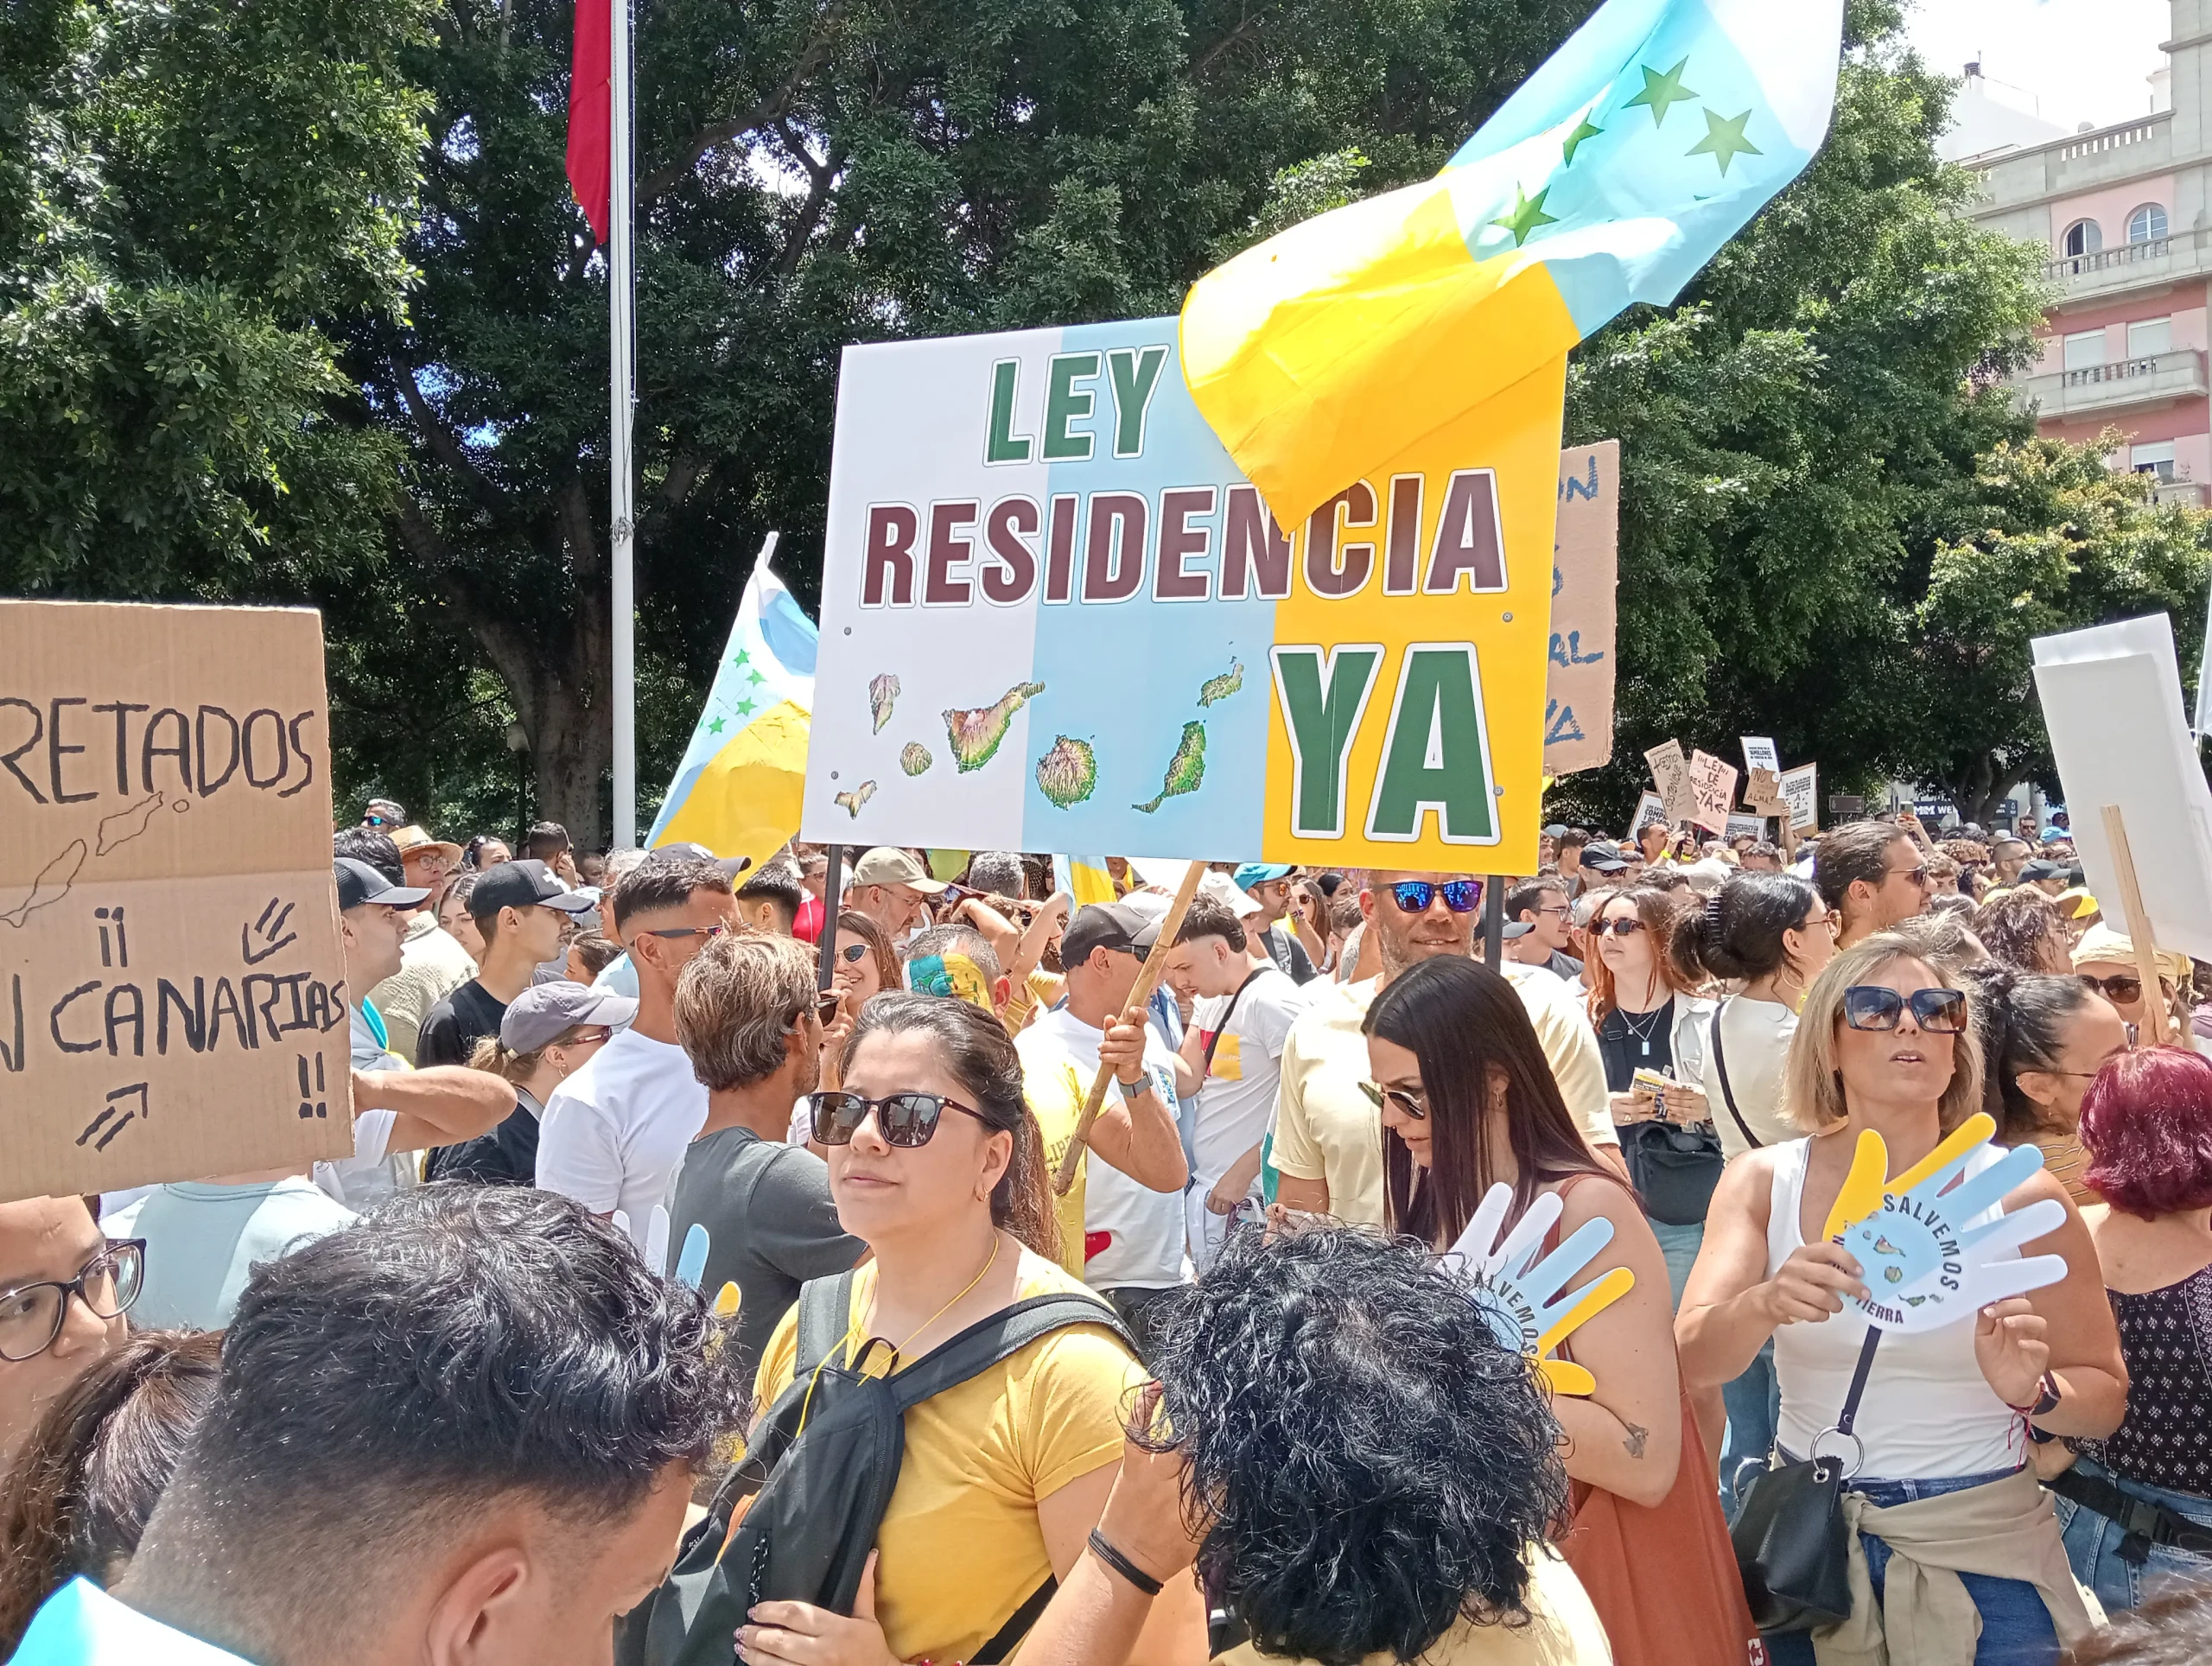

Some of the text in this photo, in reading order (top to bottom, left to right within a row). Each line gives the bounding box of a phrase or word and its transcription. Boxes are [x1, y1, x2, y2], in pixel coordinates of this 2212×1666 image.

[983, 344, 1171, 467] LEY
[1558, 455, 1599, 503] N
[861, 467, 1510, 608] RESIDENCIA
[0, 696, 315, 805] RETADOS
[1269, 642, 1502, 845] YA
[1707, 772, 1719, 786] DE
[1753, 770, 1767, 783] NO
[1700, 790, 1713, 812] YA
[50, 971, 346, 1056] CANARIAS
[1883, 1193, 1962, 1291] SALVEMOS
